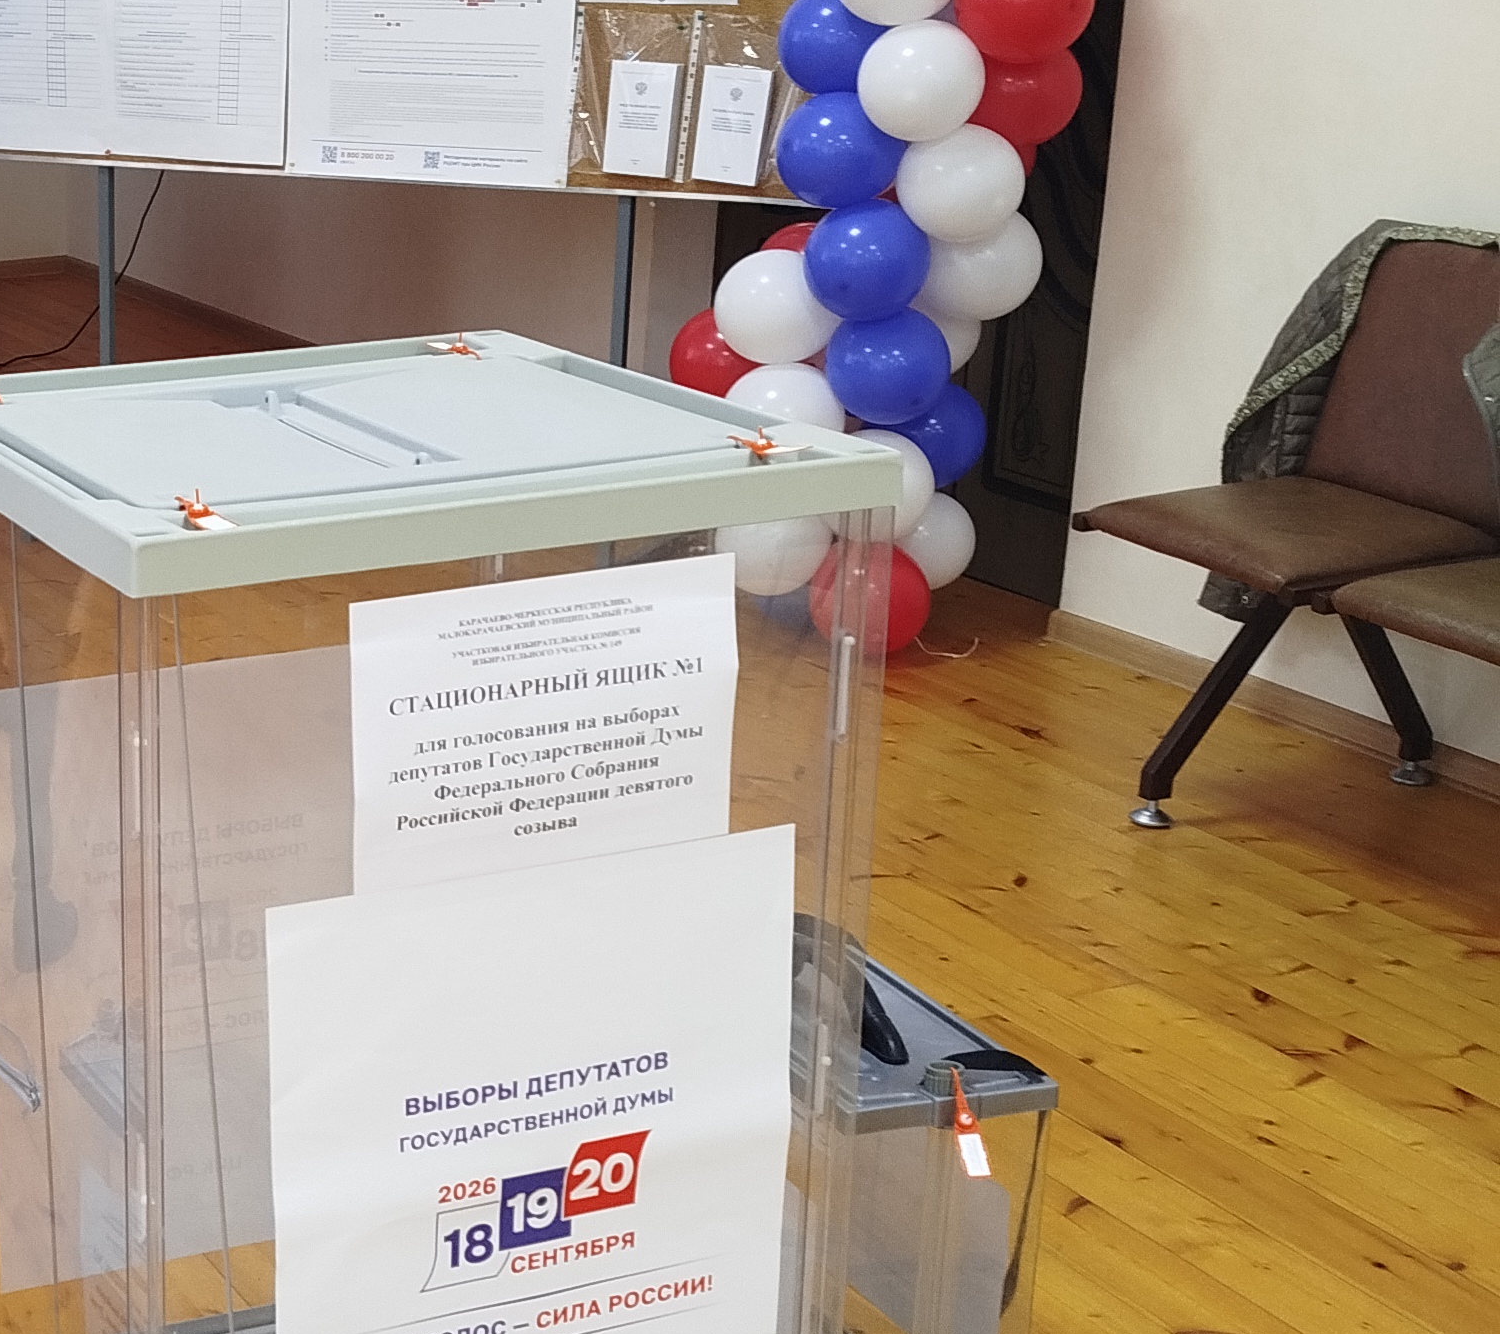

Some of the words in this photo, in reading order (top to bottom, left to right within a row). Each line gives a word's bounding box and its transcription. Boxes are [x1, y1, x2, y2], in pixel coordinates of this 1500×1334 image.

[389, 668, 588, 717] СТАЦИОНАРНЫЙ
[595, 661, 668, 688] ЯЩИК
[671, 657, 703, 677] №1
[388, 758, 483, 786] депутатов
[489, 731, 646, 768] Государственной
[650, 724, 704, 748] Думы
[414, 739, 447, 756] для
[454, 721, 570, 753] голосования
[576, 716, 597, 731] на
[603, 704, 681, 729] выборах
[396, 801, 503, 832] Российской
[509, 786, 611, 815] Федерации
[614, 773, 694, 800] девятого
[434, 769, 566, 801] Федерального
[570, 755, 660, 781] Собрания
[513, 814, 578, 837] созыва
[404, 1080, 518, 1117] ВЫБОРЫ
[525, 1051, 669, 1100] ДЕПУТАТОВ
[399, 1097, 607, 1153] ГОСУДАРСТВЕННОЙ
[612, 1087, 674, 1116] ДУМЫ
[437, 1176, 496, 1205] 2026
[443, 1223, 494, 1269] 18
[505, 1186, 559, 1234] 19
[568, 1152, 635, 1202] 20
[510, 1231, 636, 1275] СЕНТЯБРЯ
[536, 1299, 602, 1329] СИЛА
[608, 1274, 714, 1313] РОССИИ!
